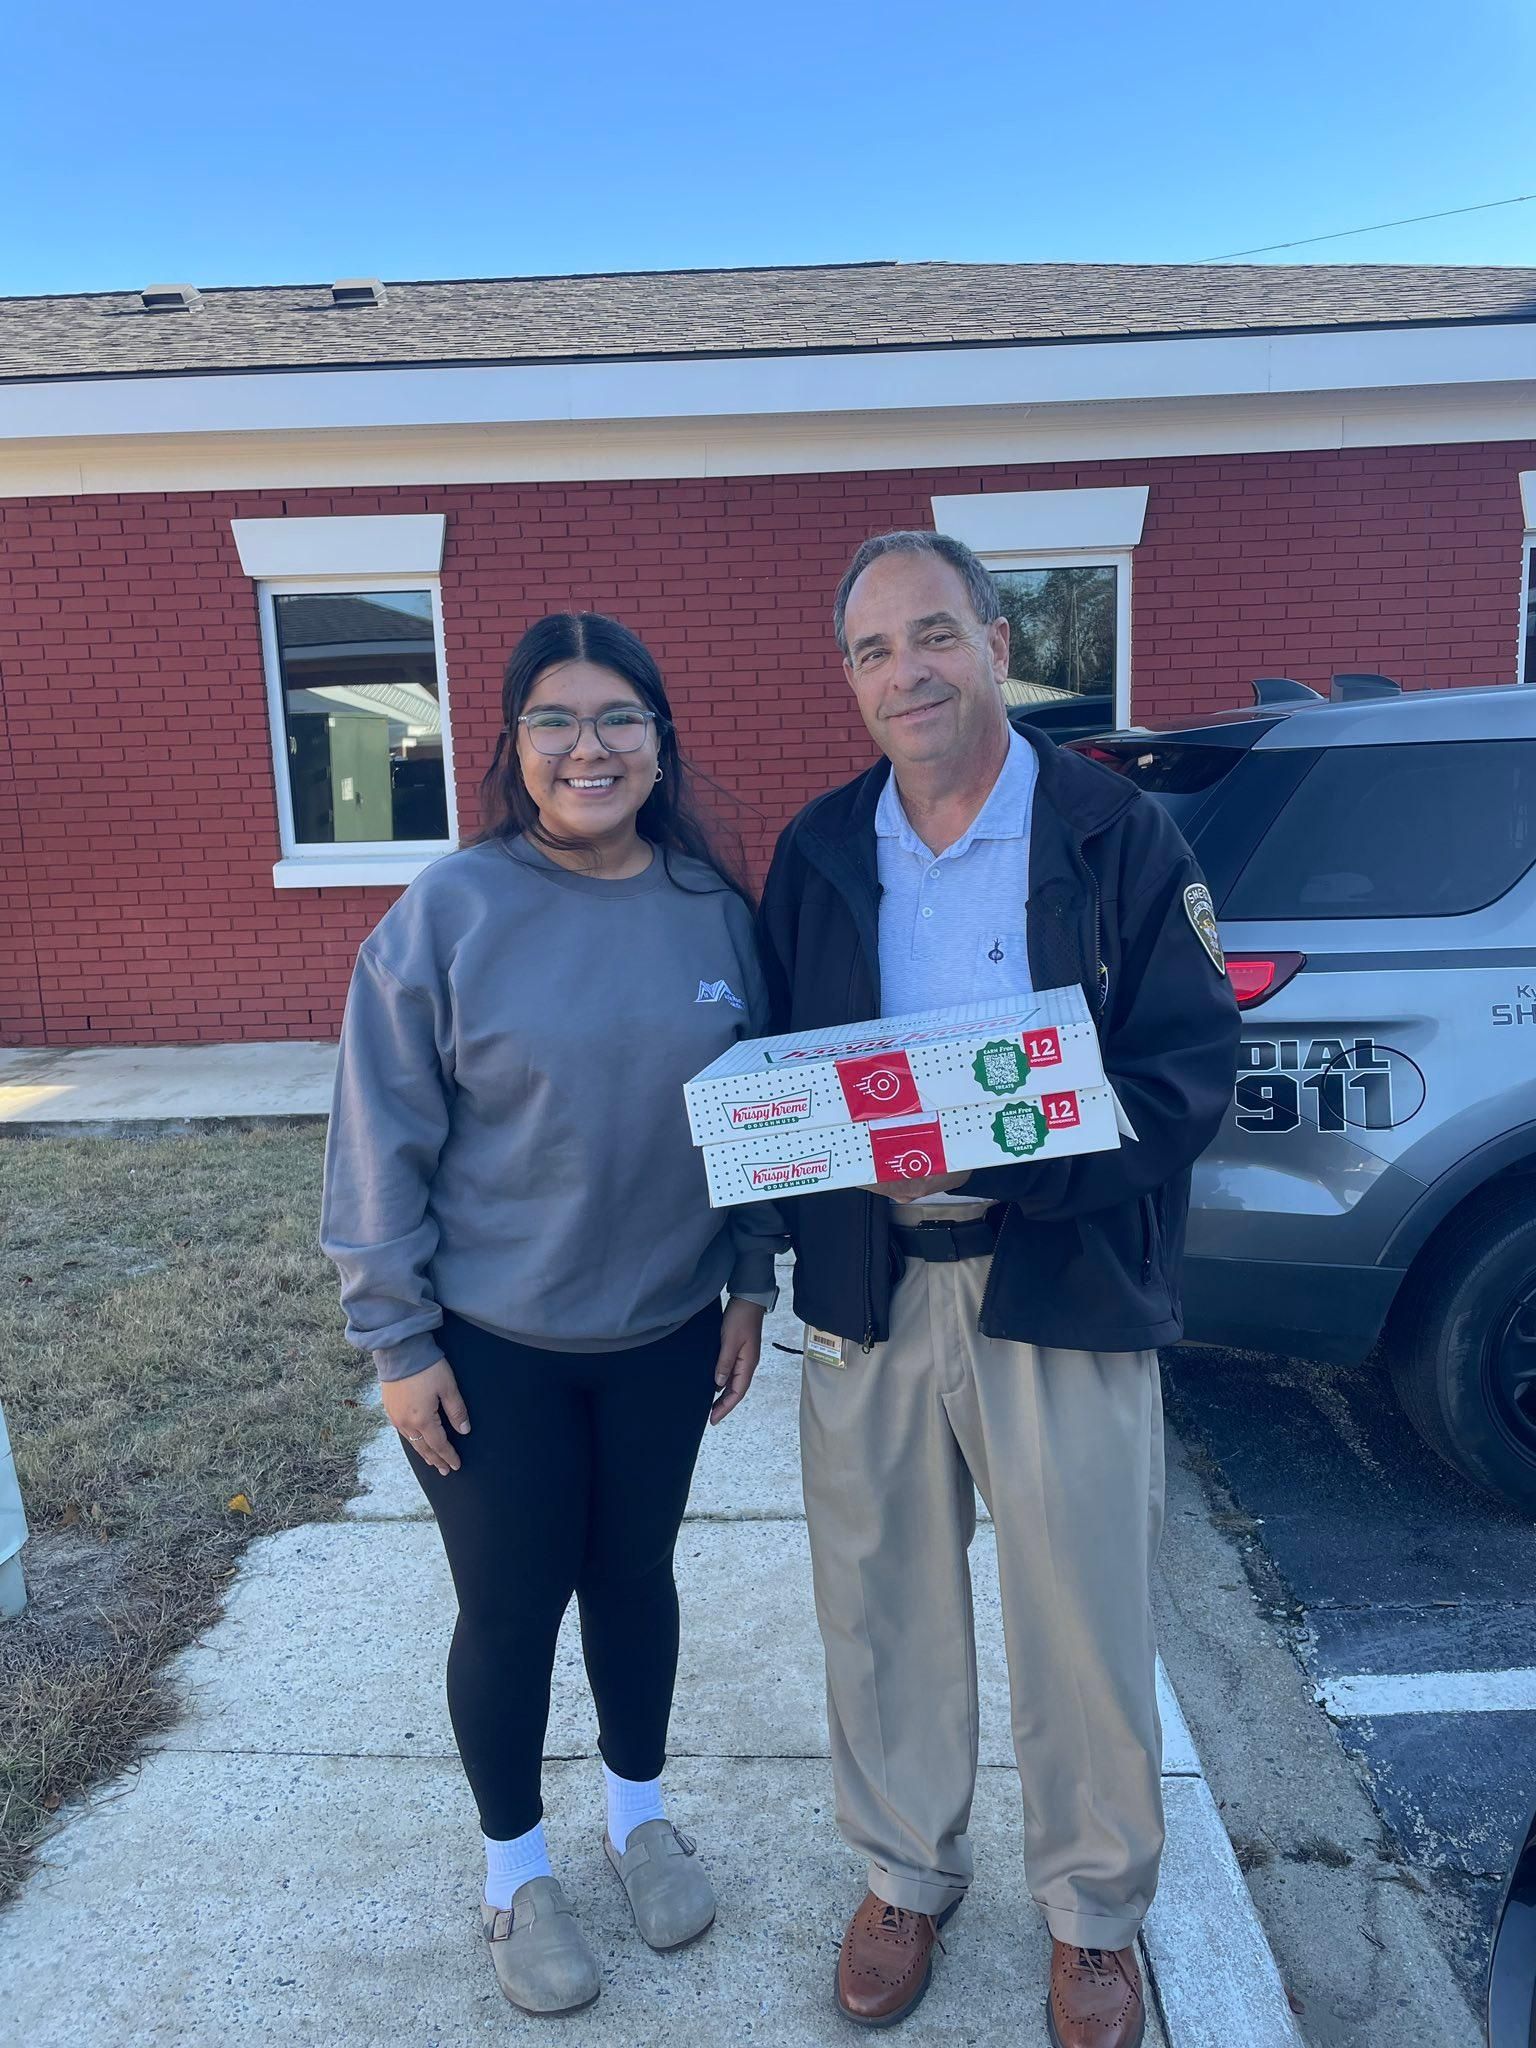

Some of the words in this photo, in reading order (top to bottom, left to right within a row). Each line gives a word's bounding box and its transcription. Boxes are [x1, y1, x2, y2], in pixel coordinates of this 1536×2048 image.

[779, 1036, 898, 1060] Krispy
[999, 1045, 1014, 1053] Free
[1029, 1038, 1056, 1058] 12
[1236, 1038, 1391, 1073] DIAL
[994, 1082, 1015, 1091] TREATS
[732, 1104, 770, 1124] Krispy
[771, 1097, 808, 1118] Kreme
[1018, 1106, 1033, 1114] Free
[1048, 1100, 1075, 1120] 12
[1234, 1071, 1394, 1134] 911
[746, 1117, 798, 1130] DOUGHNUTS
[752, 1164, 790, 1185] Krispy
[791, 1158, 828, 1178] Kreme
[765, 1177, 817, 1191] DOUGHNUTS
